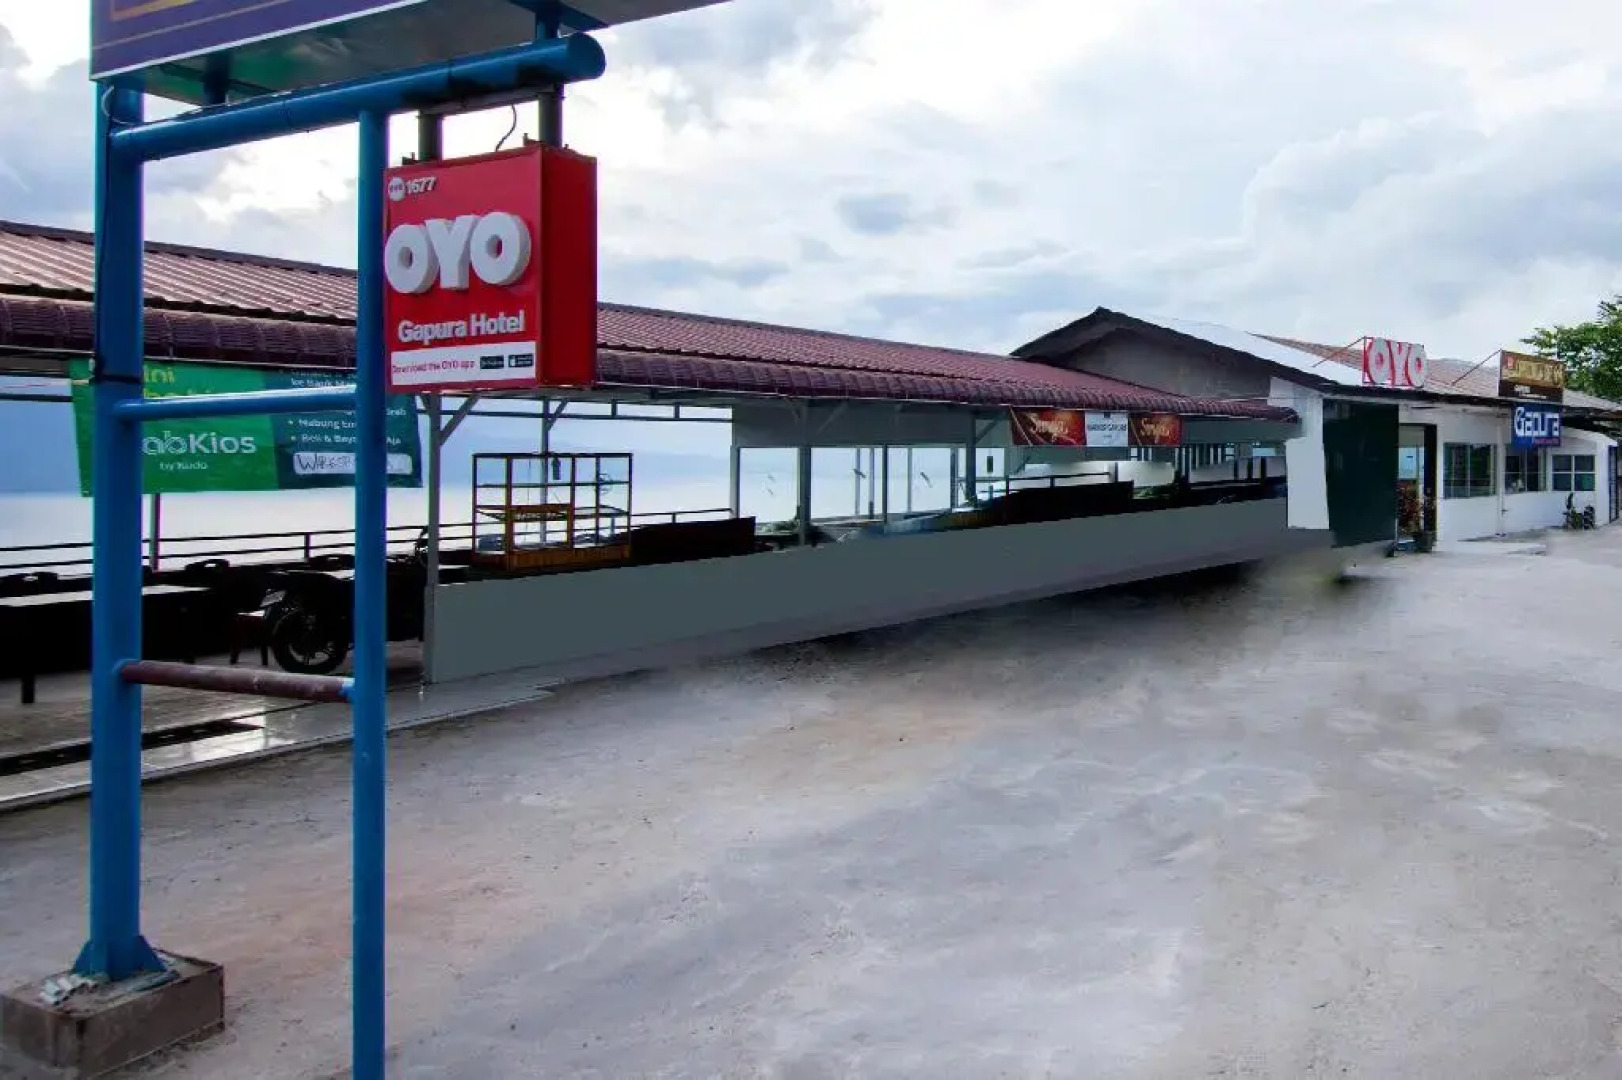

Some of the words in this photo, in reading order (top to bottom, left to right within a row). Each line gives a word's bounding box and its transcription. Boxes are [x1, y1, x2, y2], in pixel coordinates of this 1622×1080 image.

[405, 176, 436, 195] 1677
[384, 211, 532, 294] OYO
[398, 320, 467, 345] Gapura
[470, 309, 526, 337] Hotel
[392, 361, 427, 374] Download
[429, 361, 440, 371] the
[441, 359, 458, 370] OYO
[460, 360, 476, 372] app
[1363, 337, 1429, 388] OYO
[141, 430, 256, 455] abKios
